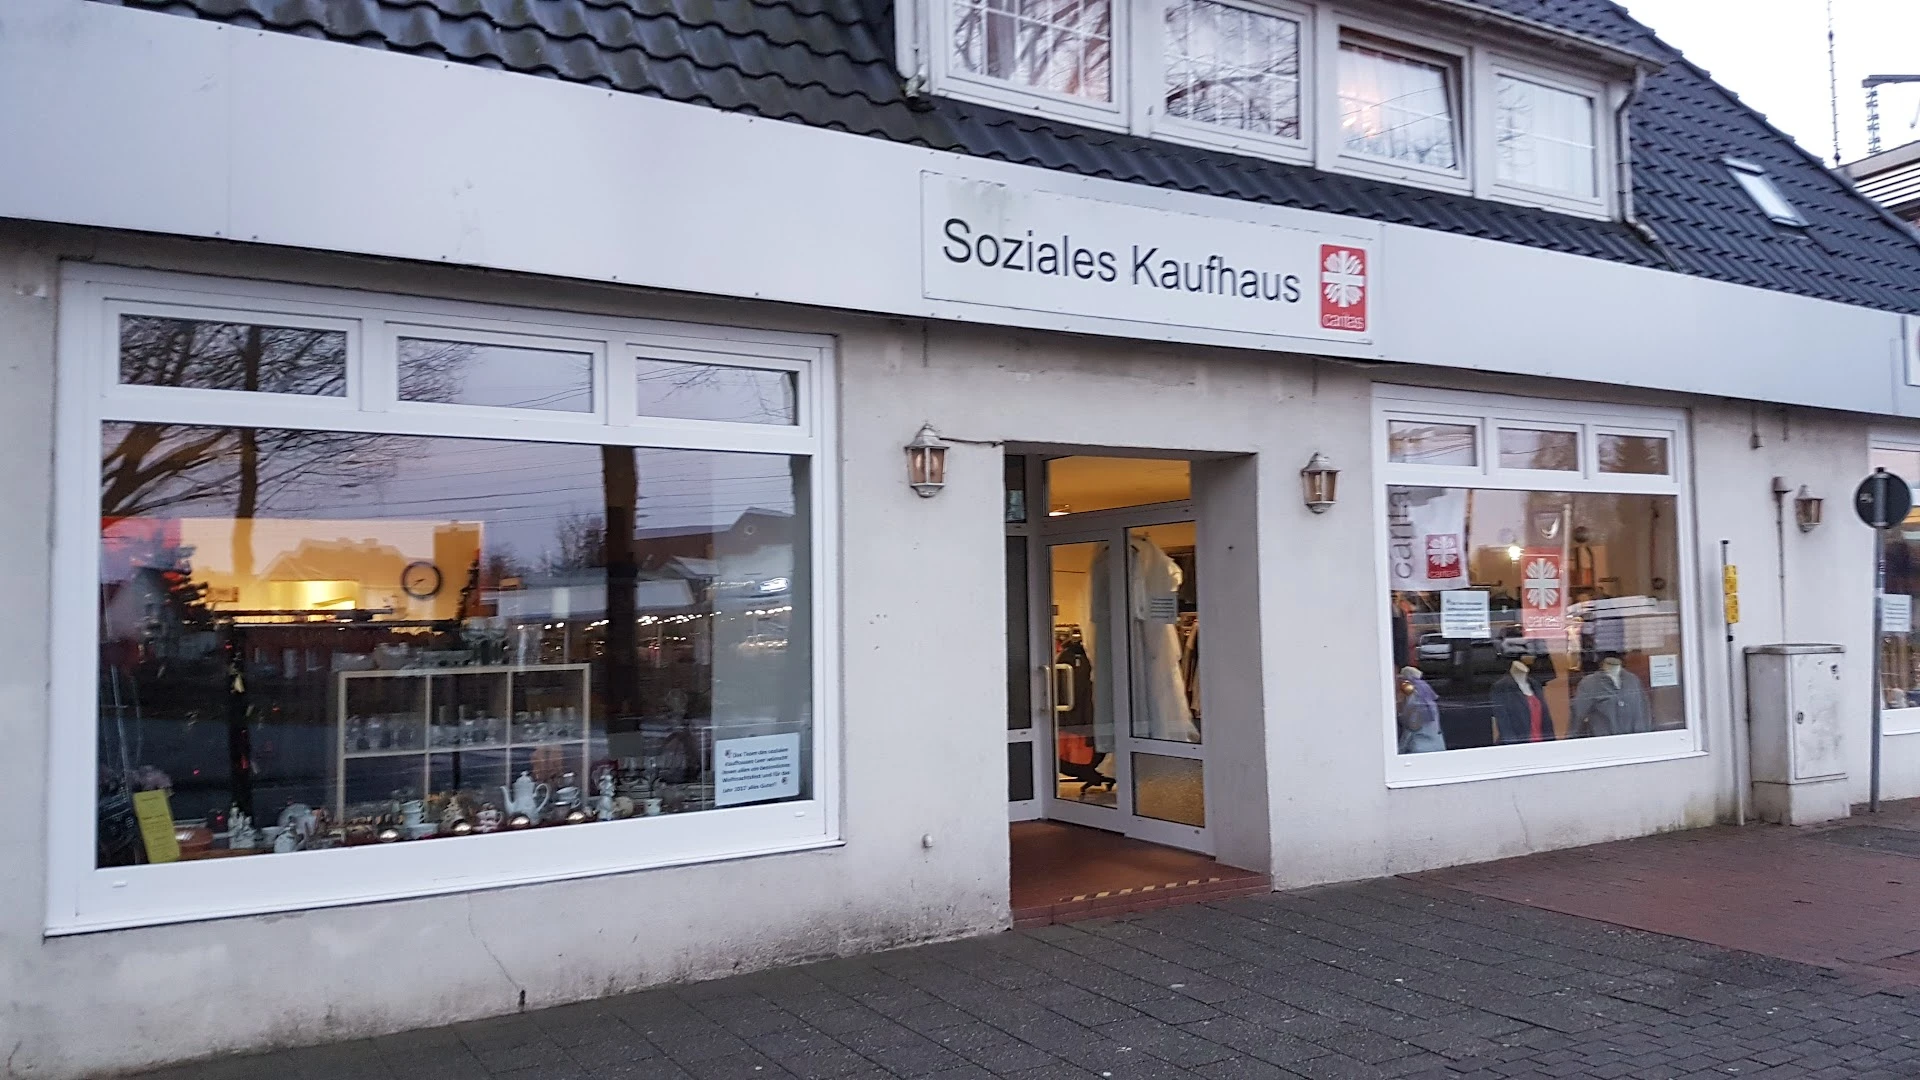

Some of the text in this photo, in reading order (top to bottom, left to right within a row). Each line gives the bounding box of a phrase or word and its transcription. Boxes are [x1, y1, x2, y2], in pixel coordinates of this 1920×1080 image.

[943, 218, 1302, 303] Soziales Kaufhaus
[1323, 313, 1365, 329] caritas
